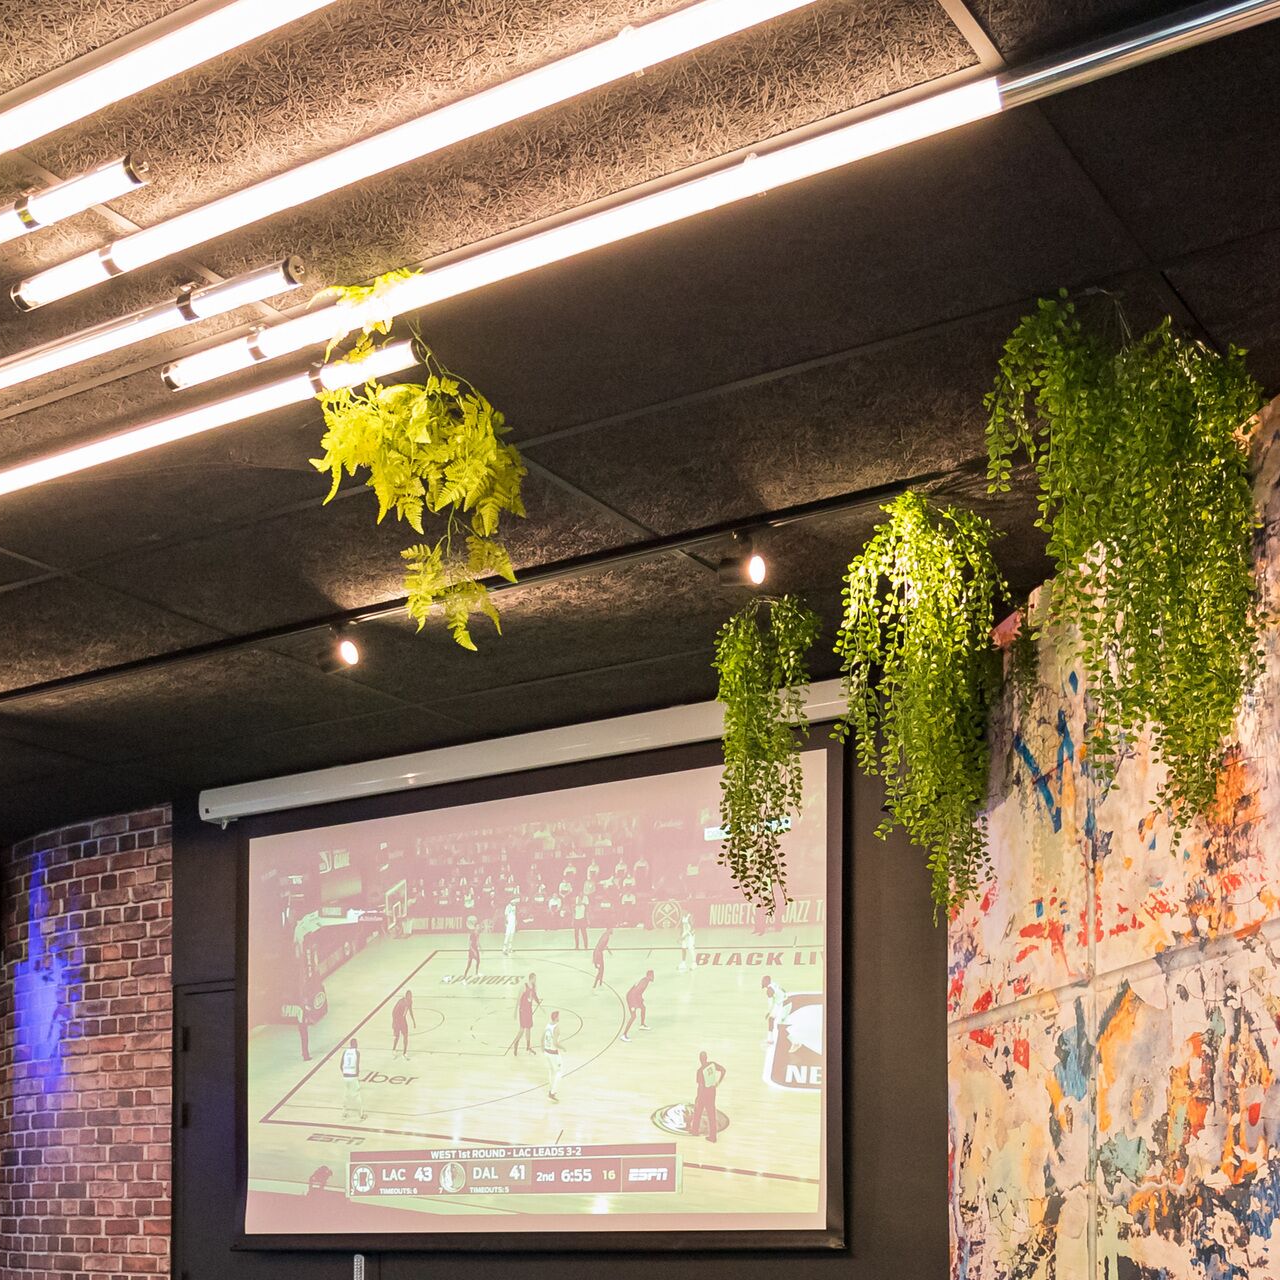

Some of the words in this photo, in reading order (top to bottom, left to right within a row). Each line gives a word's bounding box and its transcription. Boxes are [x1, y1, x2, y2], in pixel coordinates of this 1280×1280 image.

[781, 901, 811, 924] JAZZ
[695, 952, 784, 966] BLACK
[307, 1133, 367, 1146] ESPN
[431, 1150, 457, 1159] WEST
[458, 1149, 470, 1159] 1st
[472, 1149, 505, 1158] ROUND
[513, 1148, 531, 1158] LAC
[533, 1147, 564, 1157] LEADS
[566, 1147, 582, 1156] 3-2
[382, 1168, 406, 1181] LAC
[414, 1167, 433, 1182] 43
[472, 1167, 499, 1180] DAL
[509, 1164, 526, 1180] 41
[536, 1171, 555, 1182] 2nd
[561, 1168, 592, 1183] 6:55
[602, 1169, 616, 1180] 16
[628, 1168, 668, 1181] ESPN
[379, 1187, 412, 1195] TIMEOUTS:
[470, 1186, 504, 1194] TIMEOUTS:
